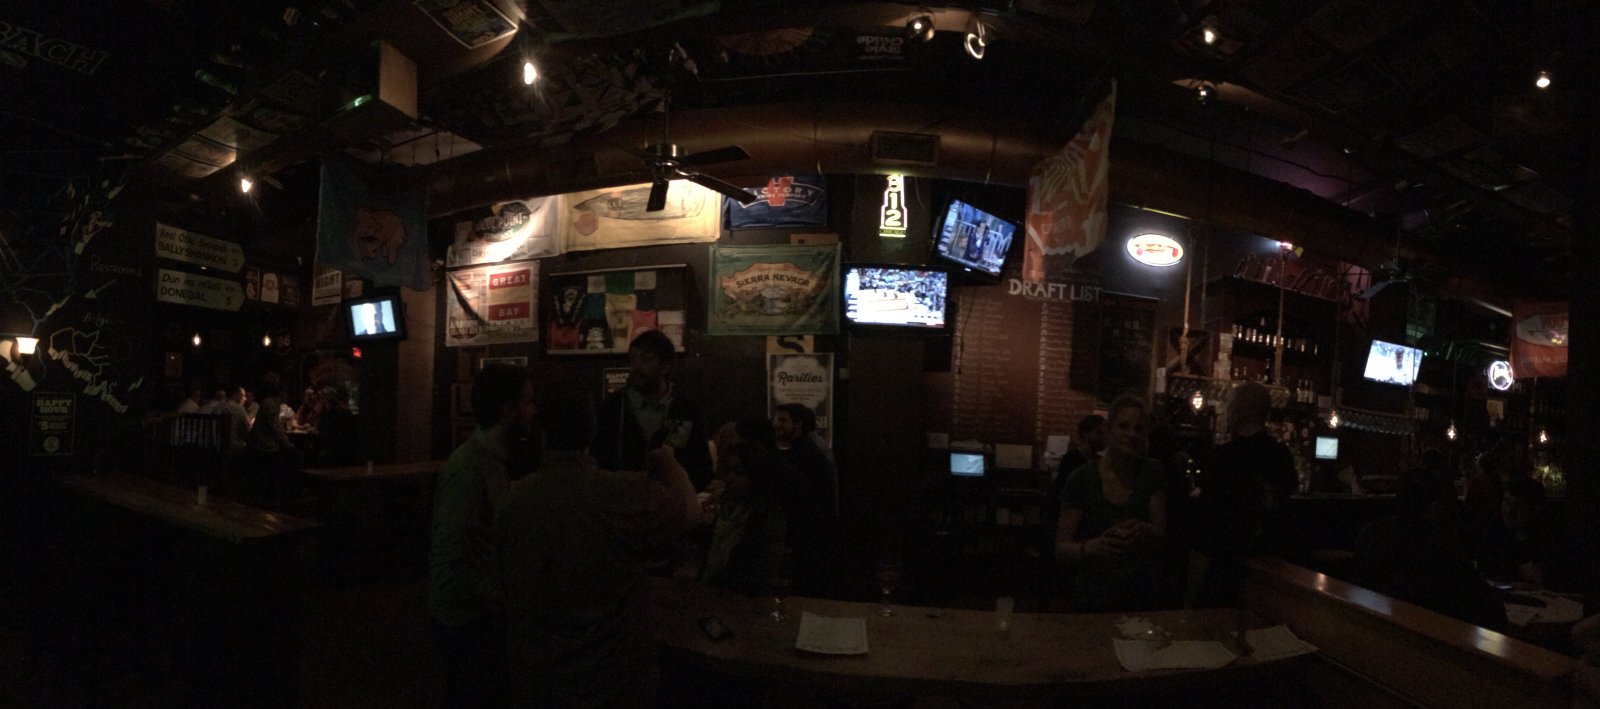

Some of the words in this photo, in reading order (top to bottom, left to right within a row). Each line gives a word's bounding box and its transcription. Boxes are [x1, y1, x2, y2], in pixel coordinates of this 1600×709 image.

[158, 241, 226, 264] BALLYSHANNON
[492, 274, 526, 286] GREAT
[736, 274, 770, 288] SIERRA
[772, 273, 810, 287] NEVADA
[160, 287, 208, 301] DONEGAL
[1008, 278, 1067, 299] DRAFT
[1070, 284, 1104, 302] LIST
[498, 306, 520, 317] BAY
[777, 371, 823, 386] Rarities
